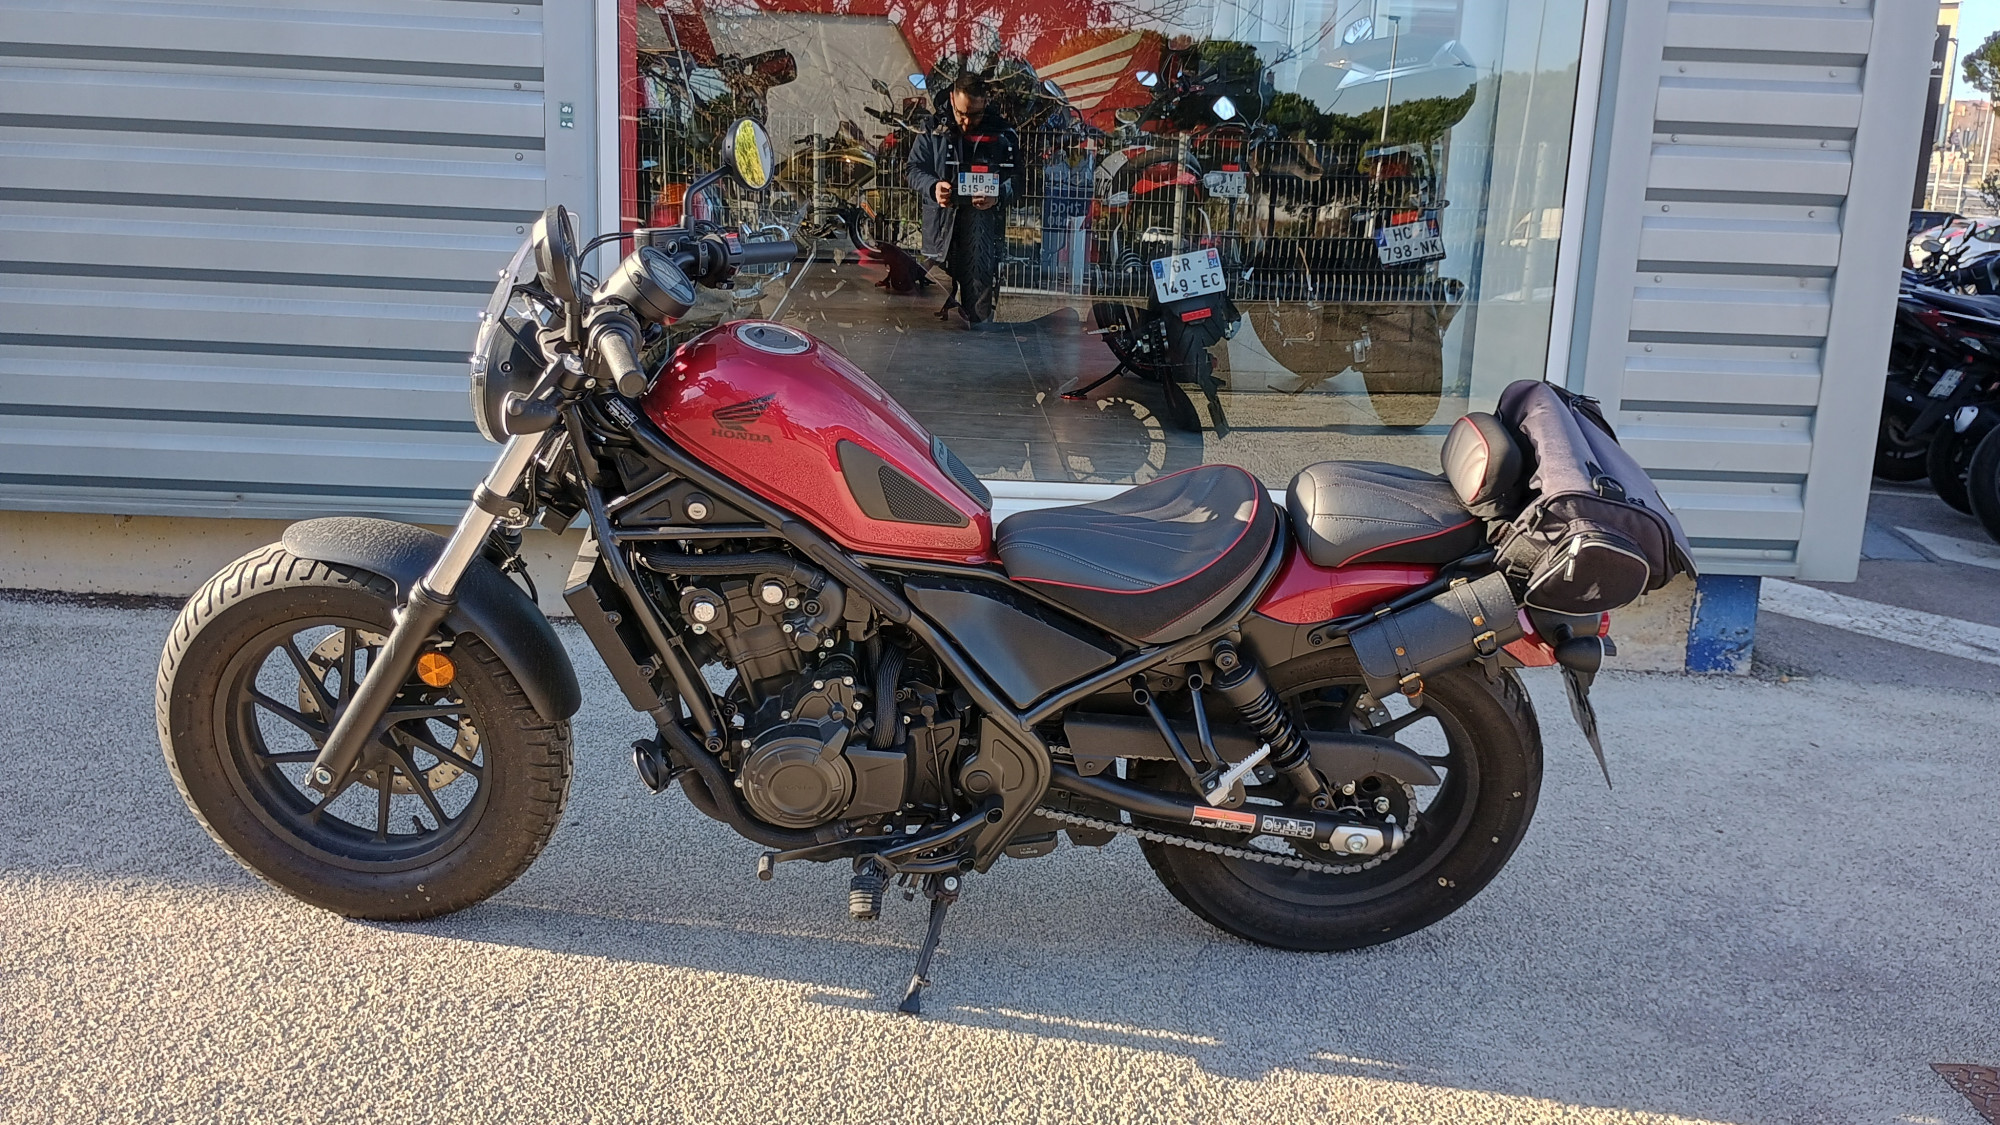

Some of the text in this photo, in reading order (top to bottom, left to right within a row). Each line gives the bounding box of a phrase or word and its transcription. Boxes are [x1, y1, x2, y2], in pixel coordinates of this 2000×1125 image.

[972, 175, 985, 184] HB
[1393, 226, 1412, 242] HC
[1383, 239, 1440, 262] 798-NK
[1172, 257, 1191, 273] GR
[1162, 272, 1220, 297] 149-EC
[711, 428, 773, 443] HONDA
